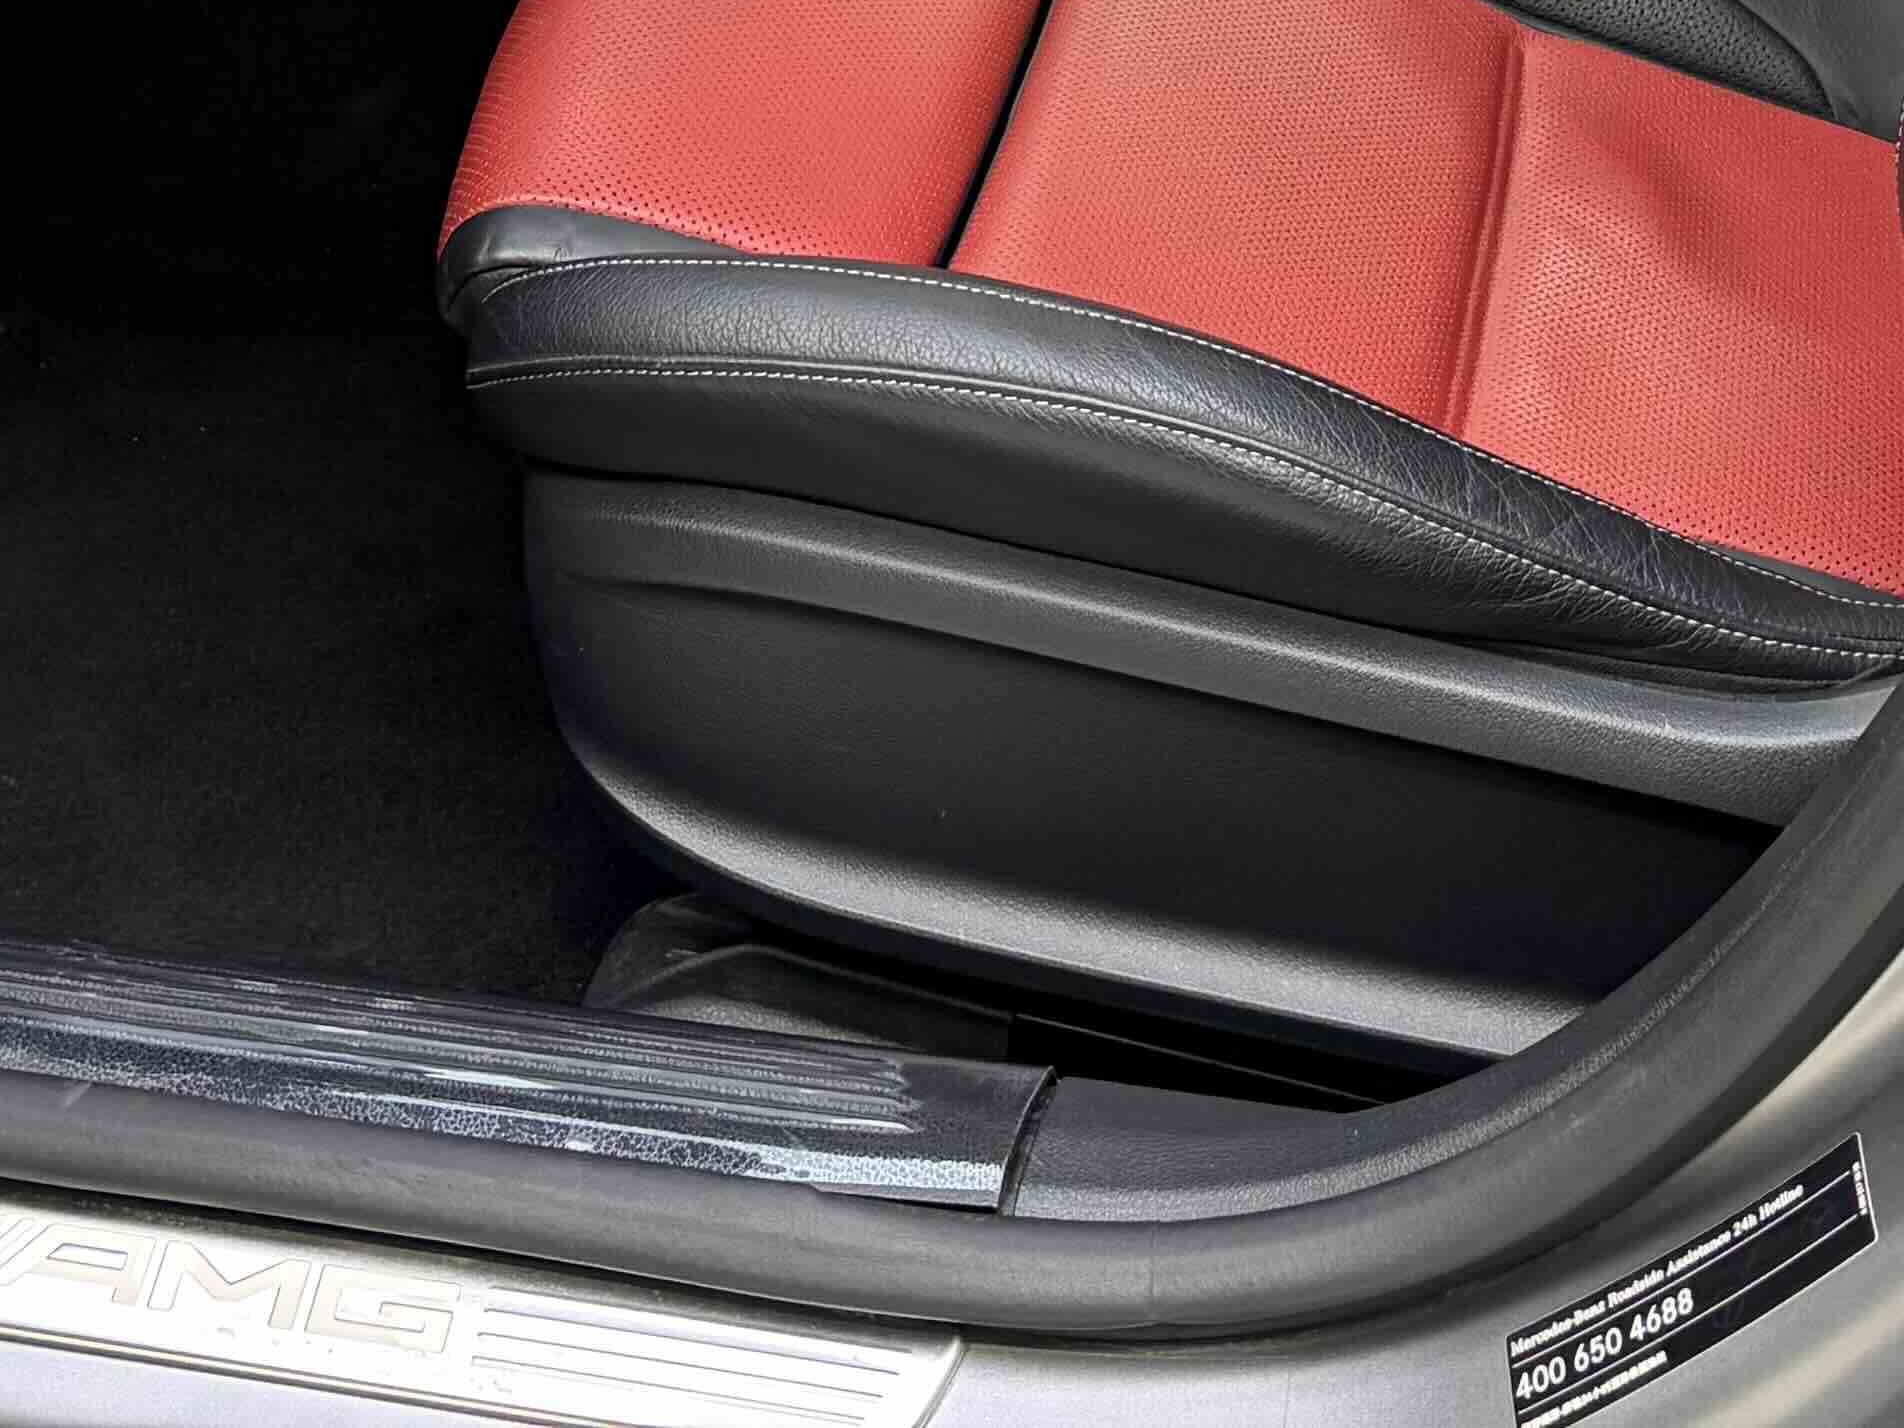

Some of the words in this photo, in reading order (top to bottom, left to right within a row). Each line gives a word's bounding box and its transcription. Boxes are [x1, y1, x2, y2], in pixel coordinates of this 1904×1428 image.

[1516, 1356, 1567, 1399] 400
[1573, 1327, 1623, 1372] 650
[1629, 1288, 1695, 1342] 4688
